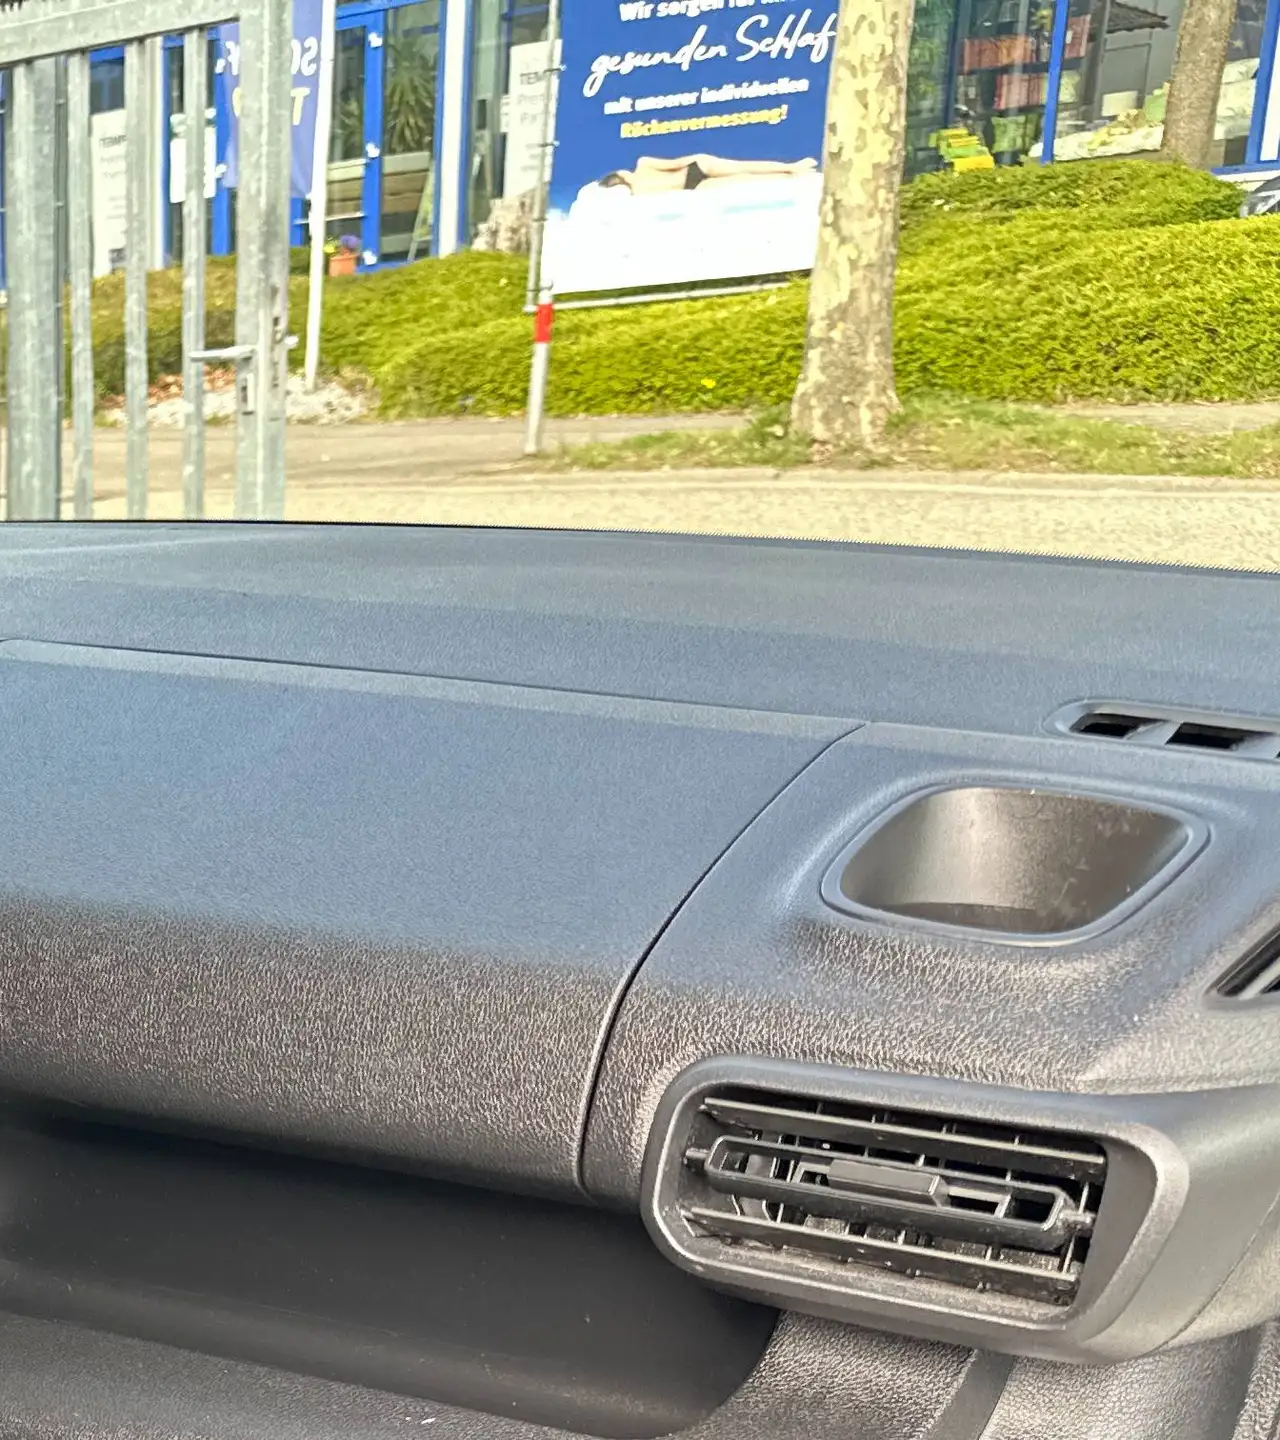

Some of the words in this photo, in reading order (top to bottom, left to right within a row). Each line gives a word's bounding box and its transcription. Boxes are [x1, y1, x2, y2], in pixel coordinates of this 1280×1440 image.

[619, 2, 655, 22] Wir
[582, 24, 728, 98] gesunden
[735, 8, 838, 63] Schlaf
